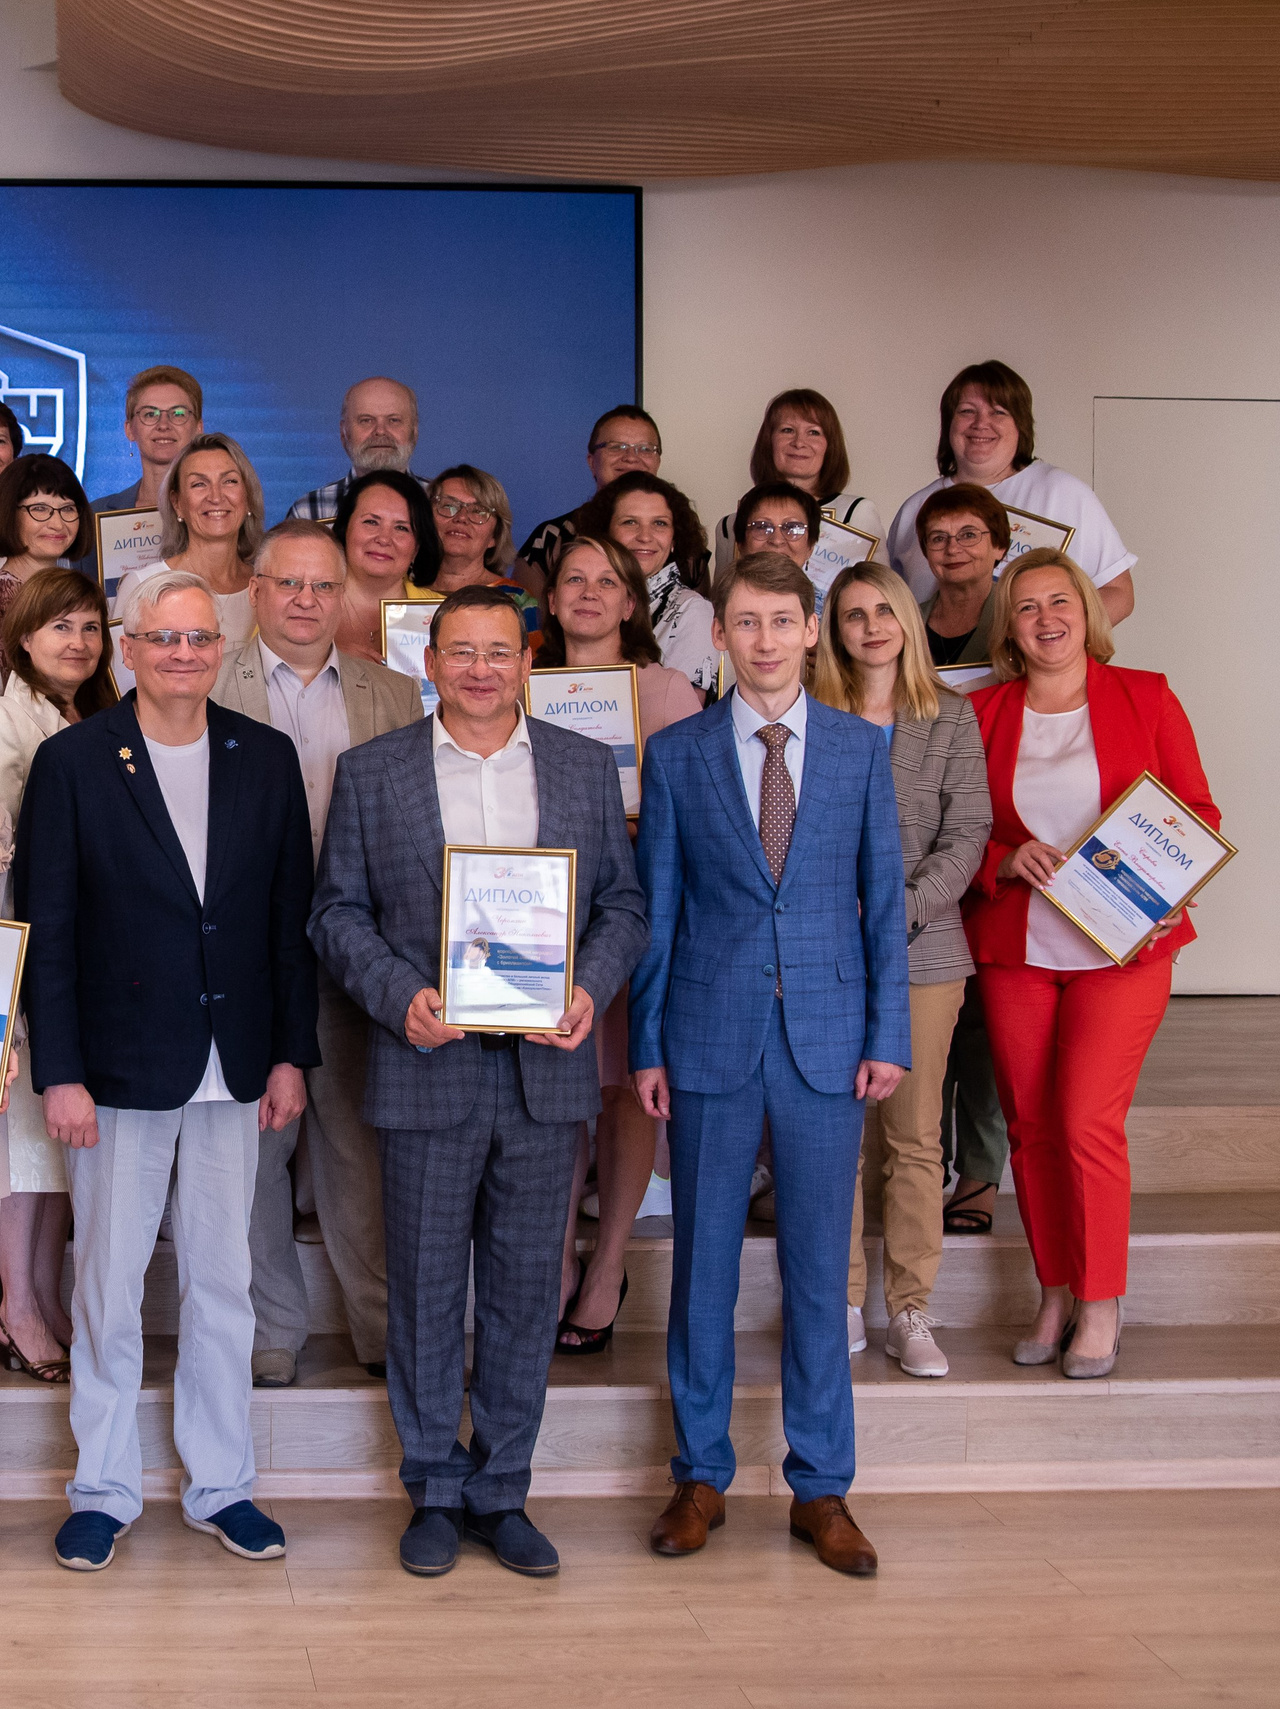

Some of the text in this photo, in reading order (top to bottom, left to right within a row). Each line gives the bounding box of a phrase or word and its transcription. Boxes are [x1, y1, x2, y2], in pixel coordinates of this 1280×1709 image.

[114, 534, 162, 550] ДИПЛО
[544, 700, 618, 716] ДИПЛОМ
[1128, 813, 1193, 870] ДИПЛОМ
[464, 887, 545, 904] ДИПЛОМ
